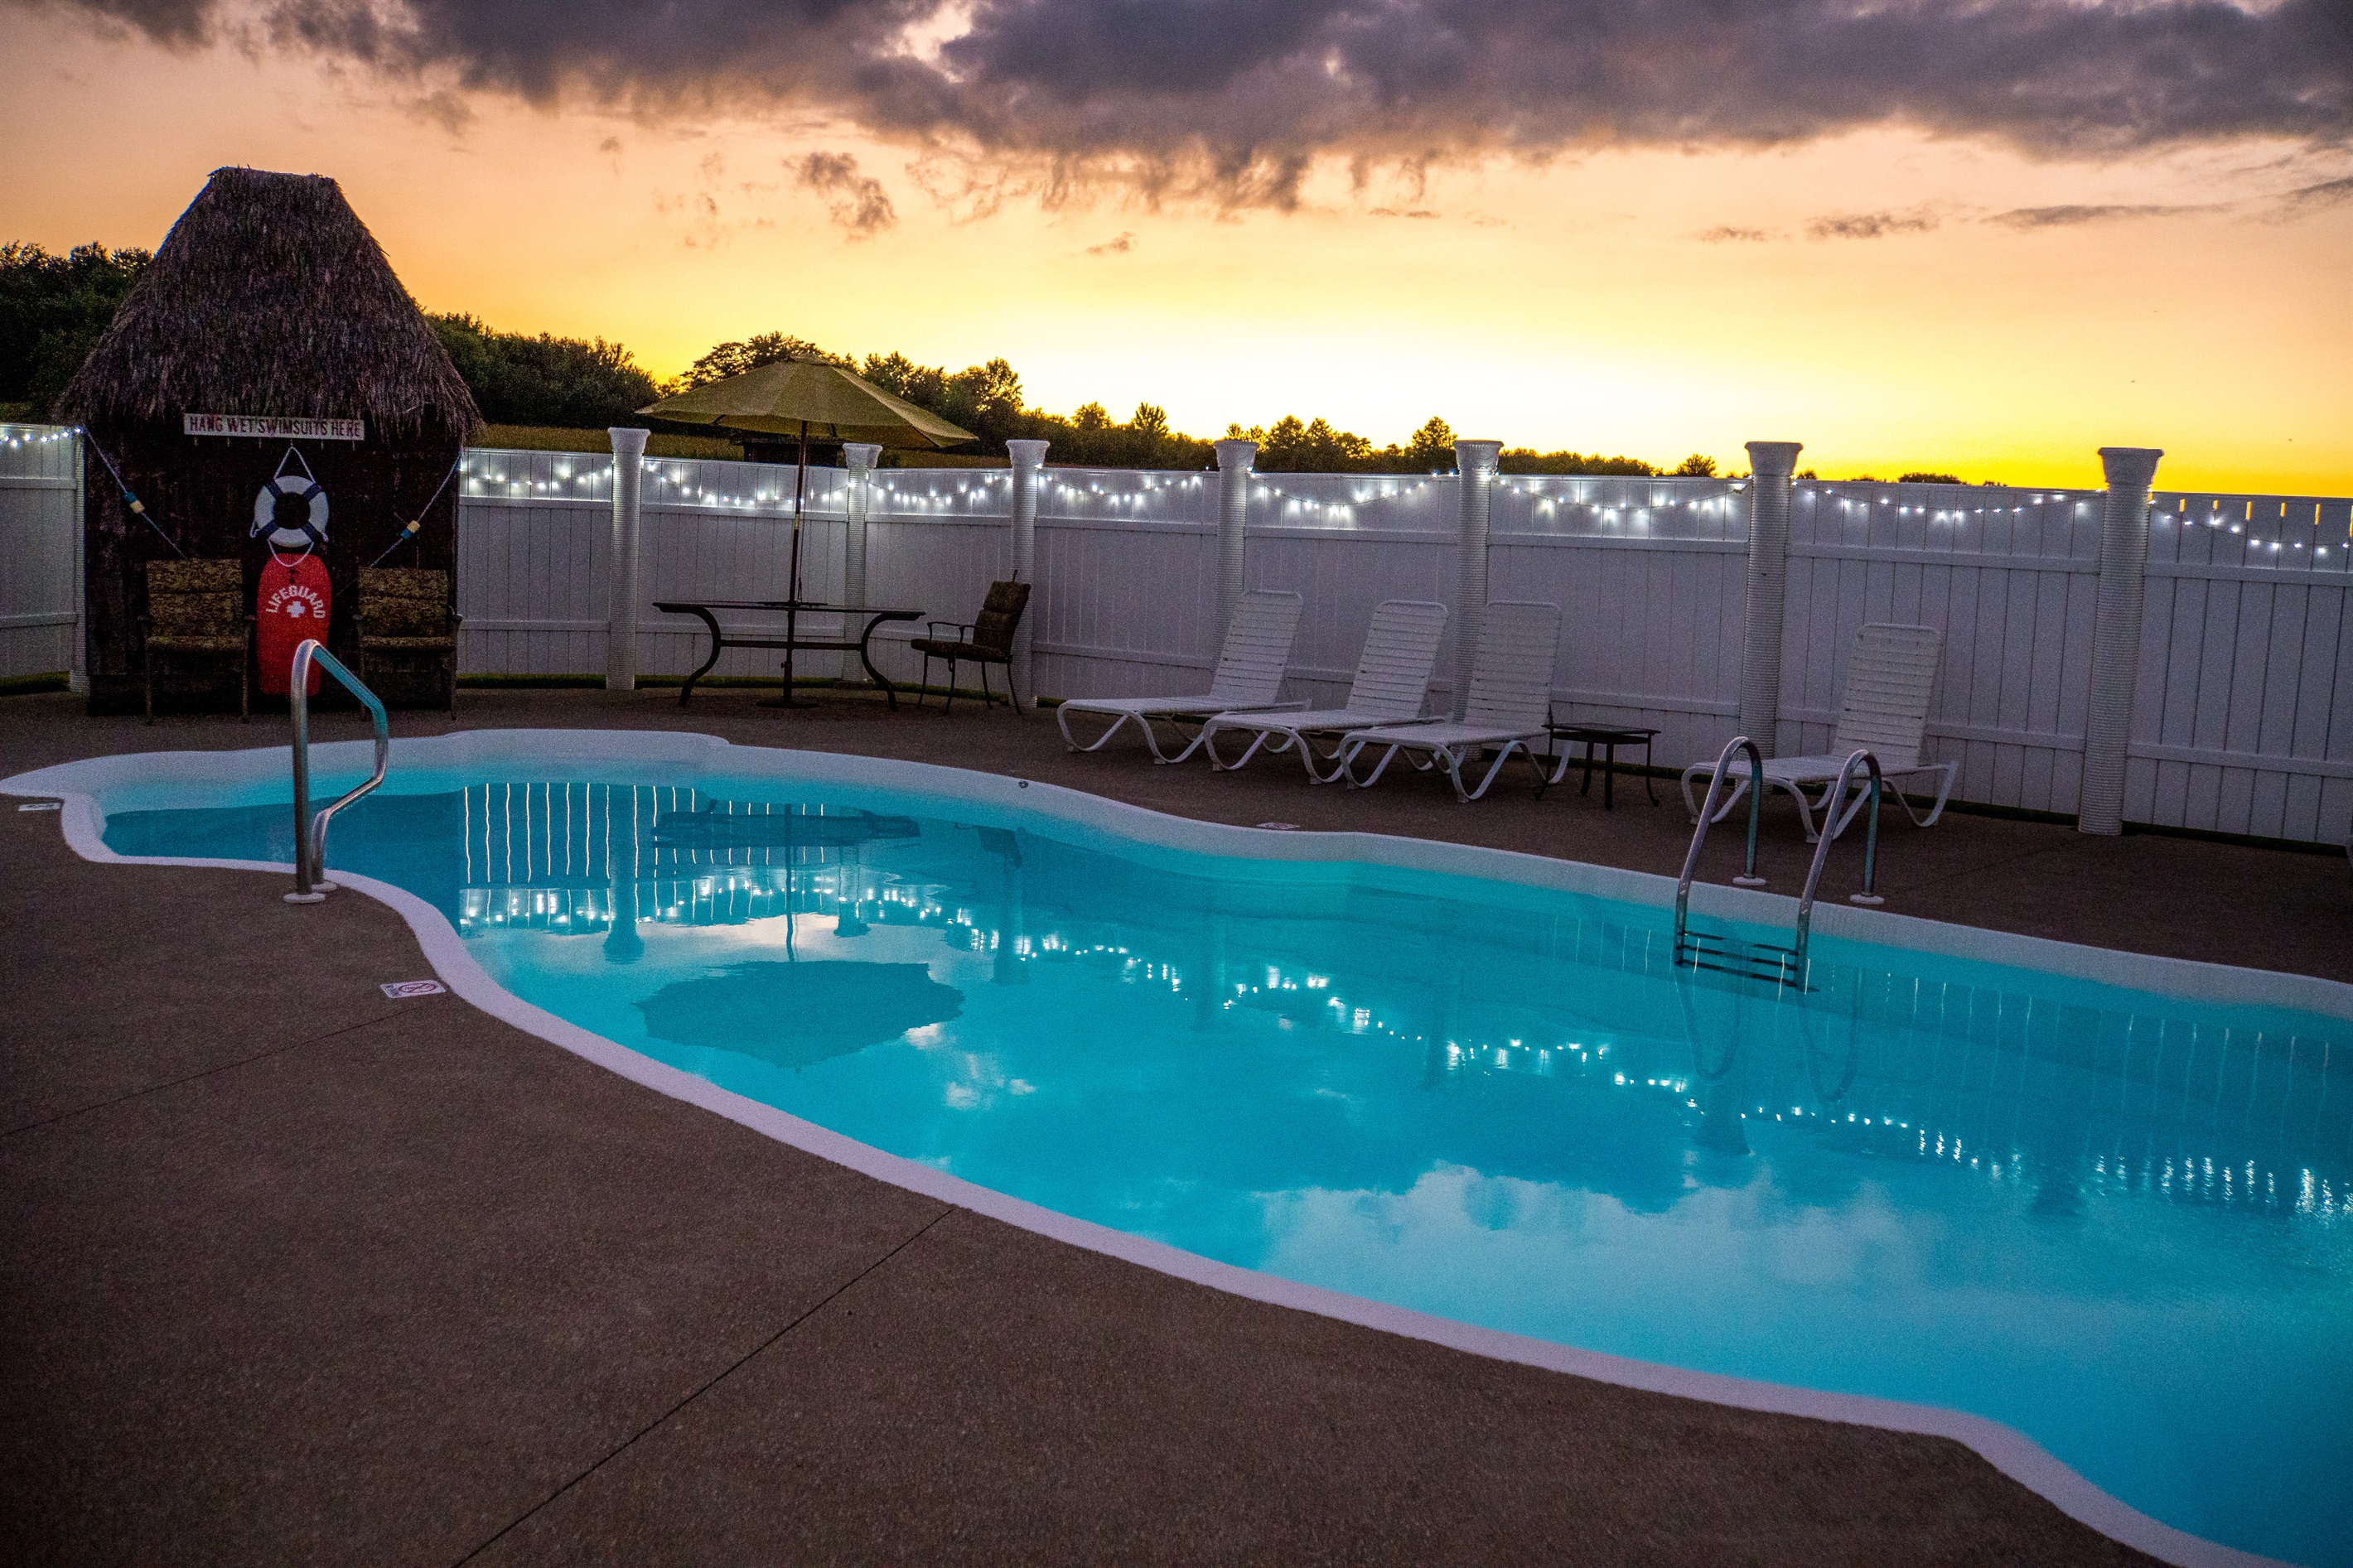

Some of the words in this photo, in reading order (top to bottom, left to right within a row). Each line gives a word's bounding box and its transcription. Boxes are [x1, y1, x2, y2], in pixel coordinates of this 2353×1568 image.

[190, 416, 223, 432] HANG
[227, 417, 254, 432] WET
[331, 420, 360, 437] HERE
[265, 585, 326, 620] LIFEGUARD
